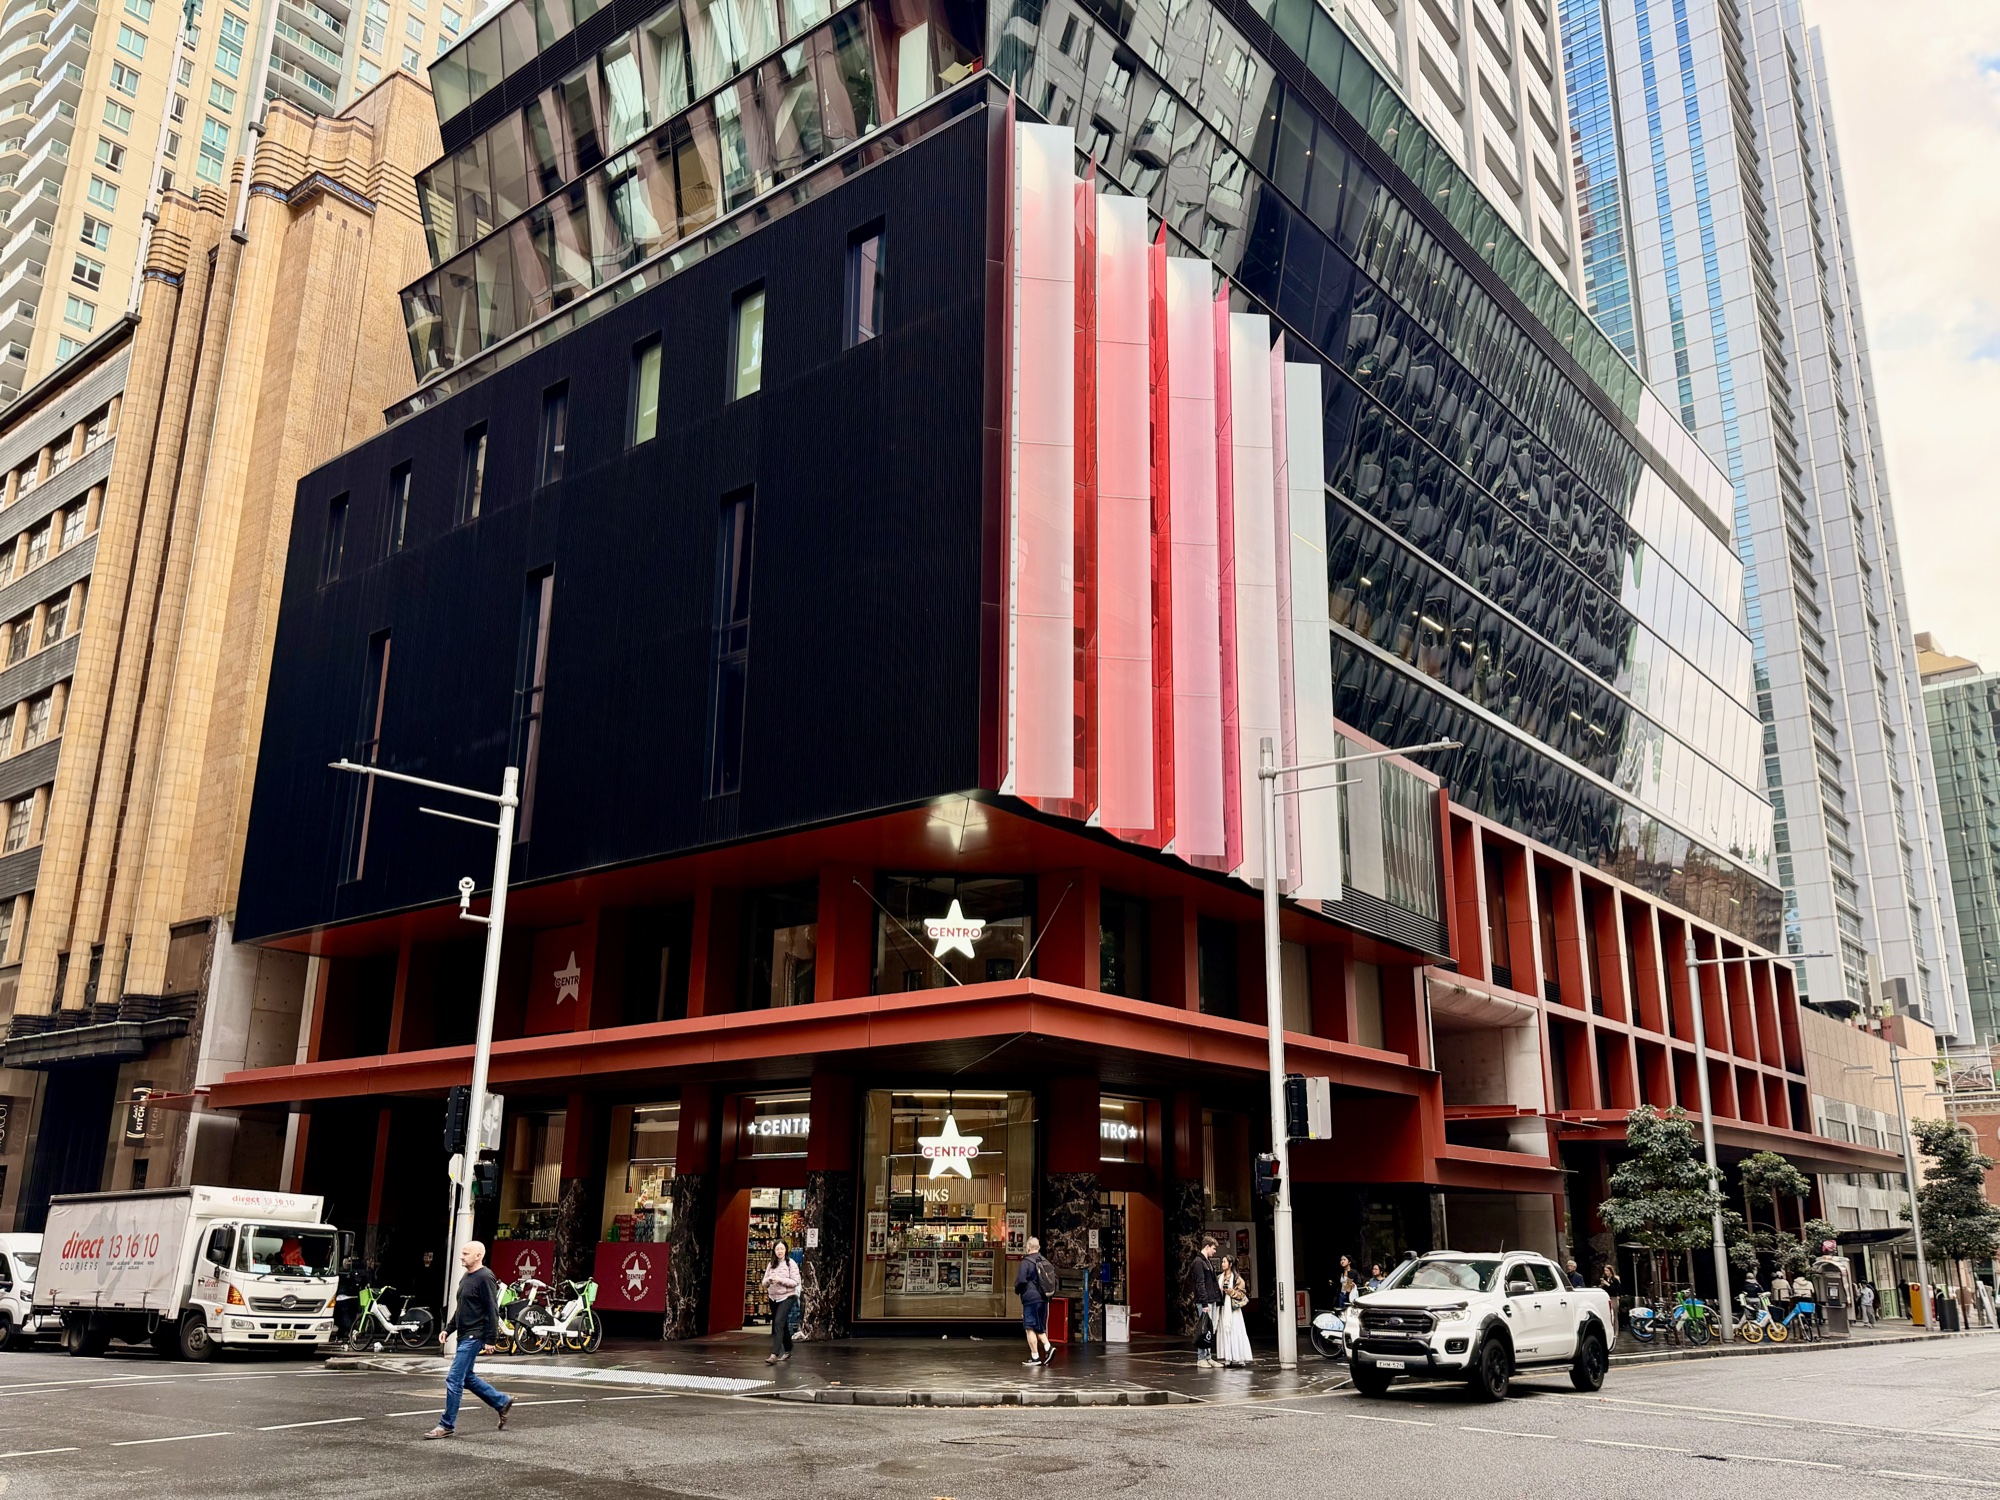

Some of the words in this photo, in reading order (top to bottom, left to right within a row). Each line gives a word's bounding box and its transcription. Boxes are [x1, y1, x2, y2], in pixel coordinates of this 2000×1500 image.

[929, 927, 980, 938] CENTRO
[135, 1095, 147, 1131] KITCHN
[1101, 1122, 1128, 1140] TRO
[923, 1146, 978, 1157] CENTRO
[232, 1194, 260, 1203] direct
[62, 1230, 104, 1259] direct
[108, 1234, 123, 1259] 13
[126, 1233, 141, 1258] 16
[143, 1232, 159, 1258] 10
[59, 1261, 98, 1271] COURIERS
[621, 1251, 637, 1269] ORGANIC
[639, 1251, 652, 1269] COFFEE
